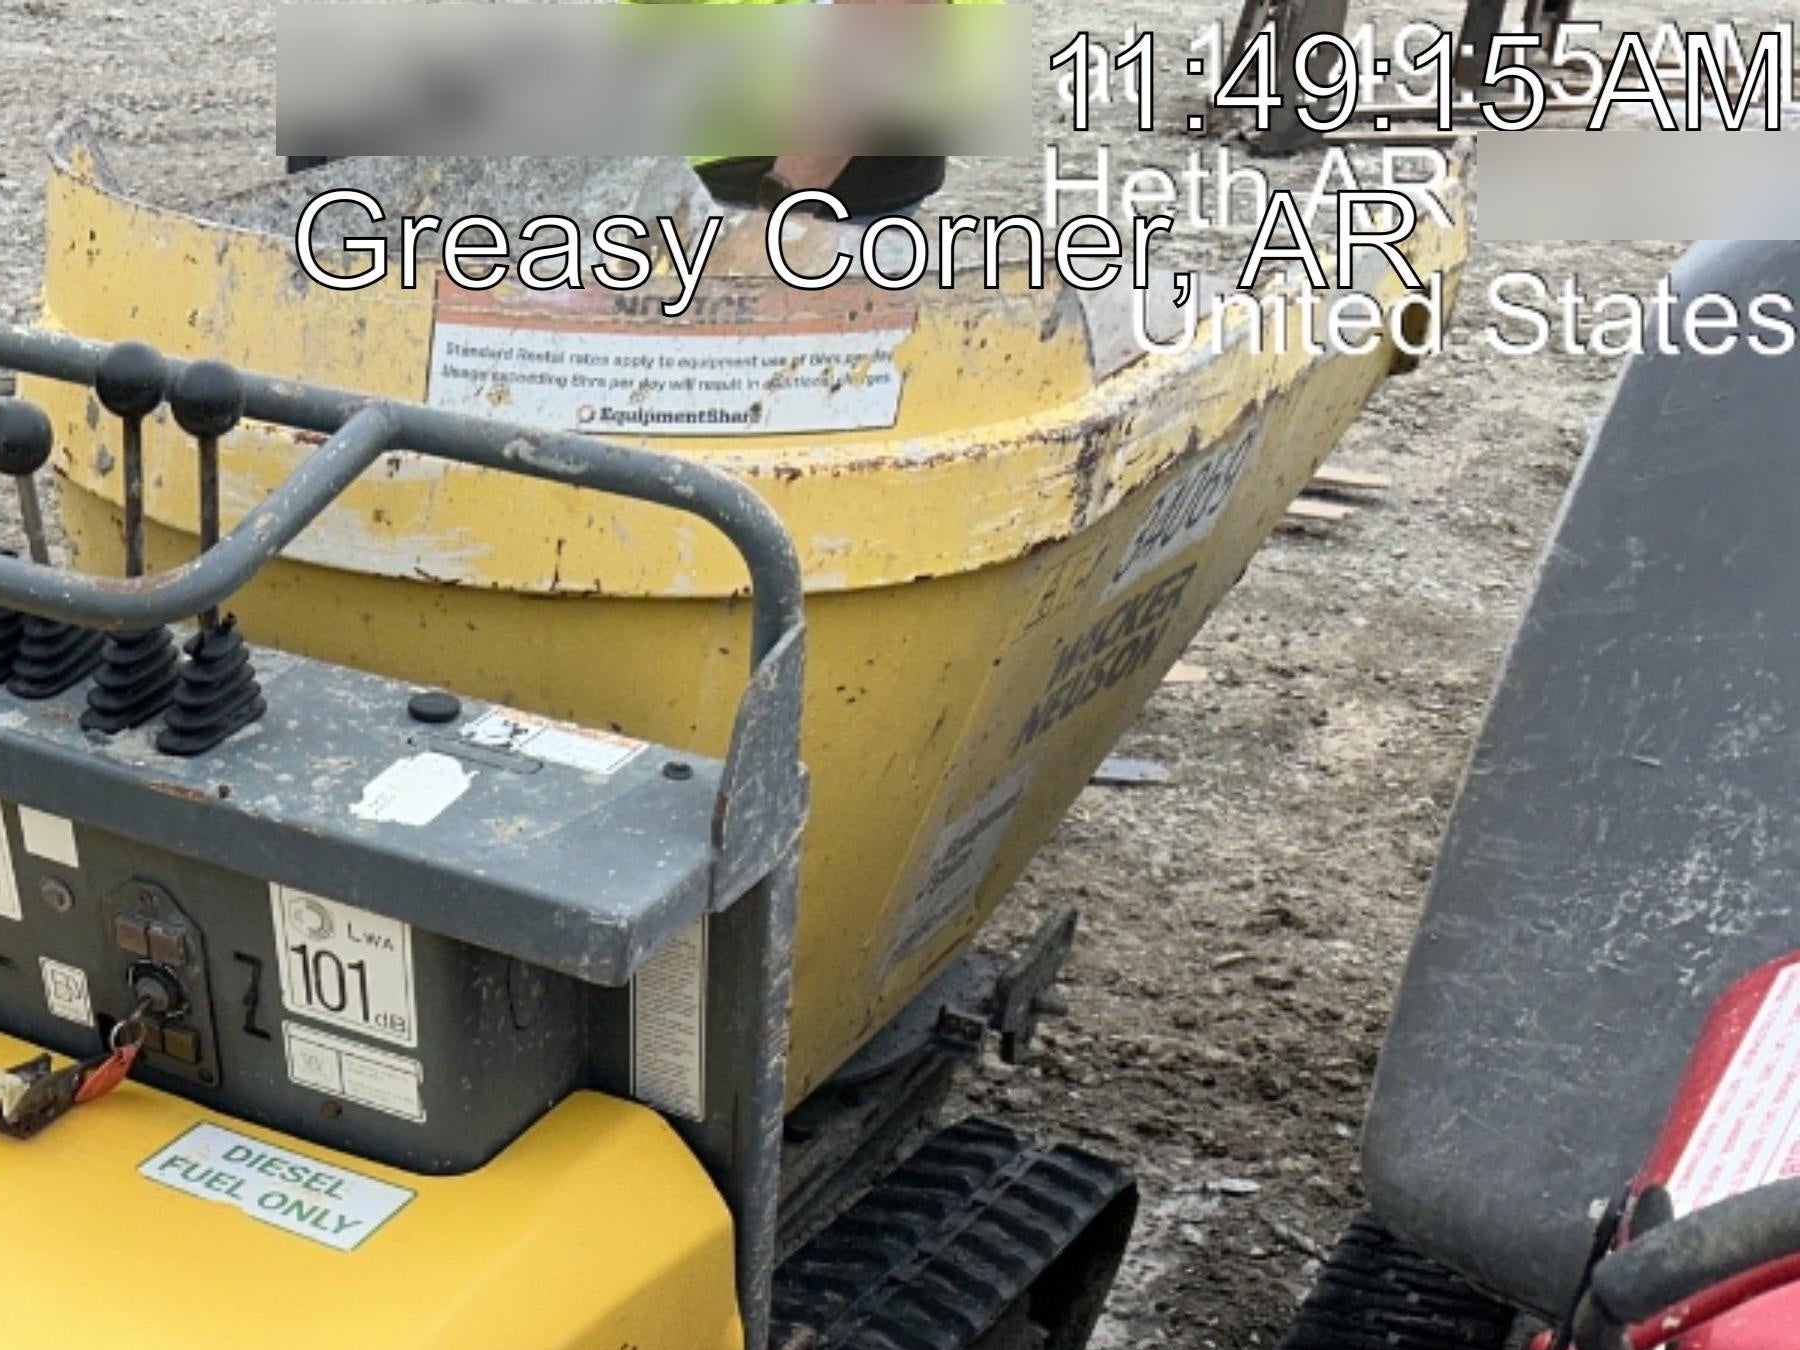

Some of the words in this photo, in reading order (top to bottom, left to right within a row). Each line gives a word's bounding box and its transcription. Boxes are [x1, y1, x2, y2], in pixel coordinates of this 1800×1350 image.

[446, 341, 513, 361] Standard
[570, 350, 610, 366] rates
[614, 354, 655, 370] apply
[659, 355, 674, 369] to
[678, 355, 758, 371] equipment
[761, 355, 787, 368] use
[699, 376, 742, 391] result
[290, 944, 370, 1024] 101
[374, 1011, 407, 1033] dB
[222, 1144, 353, 1200] DIESEL
[158, 1154, 246, 1199] FUEL
[256, 1190, 363, 1235] ONLY
